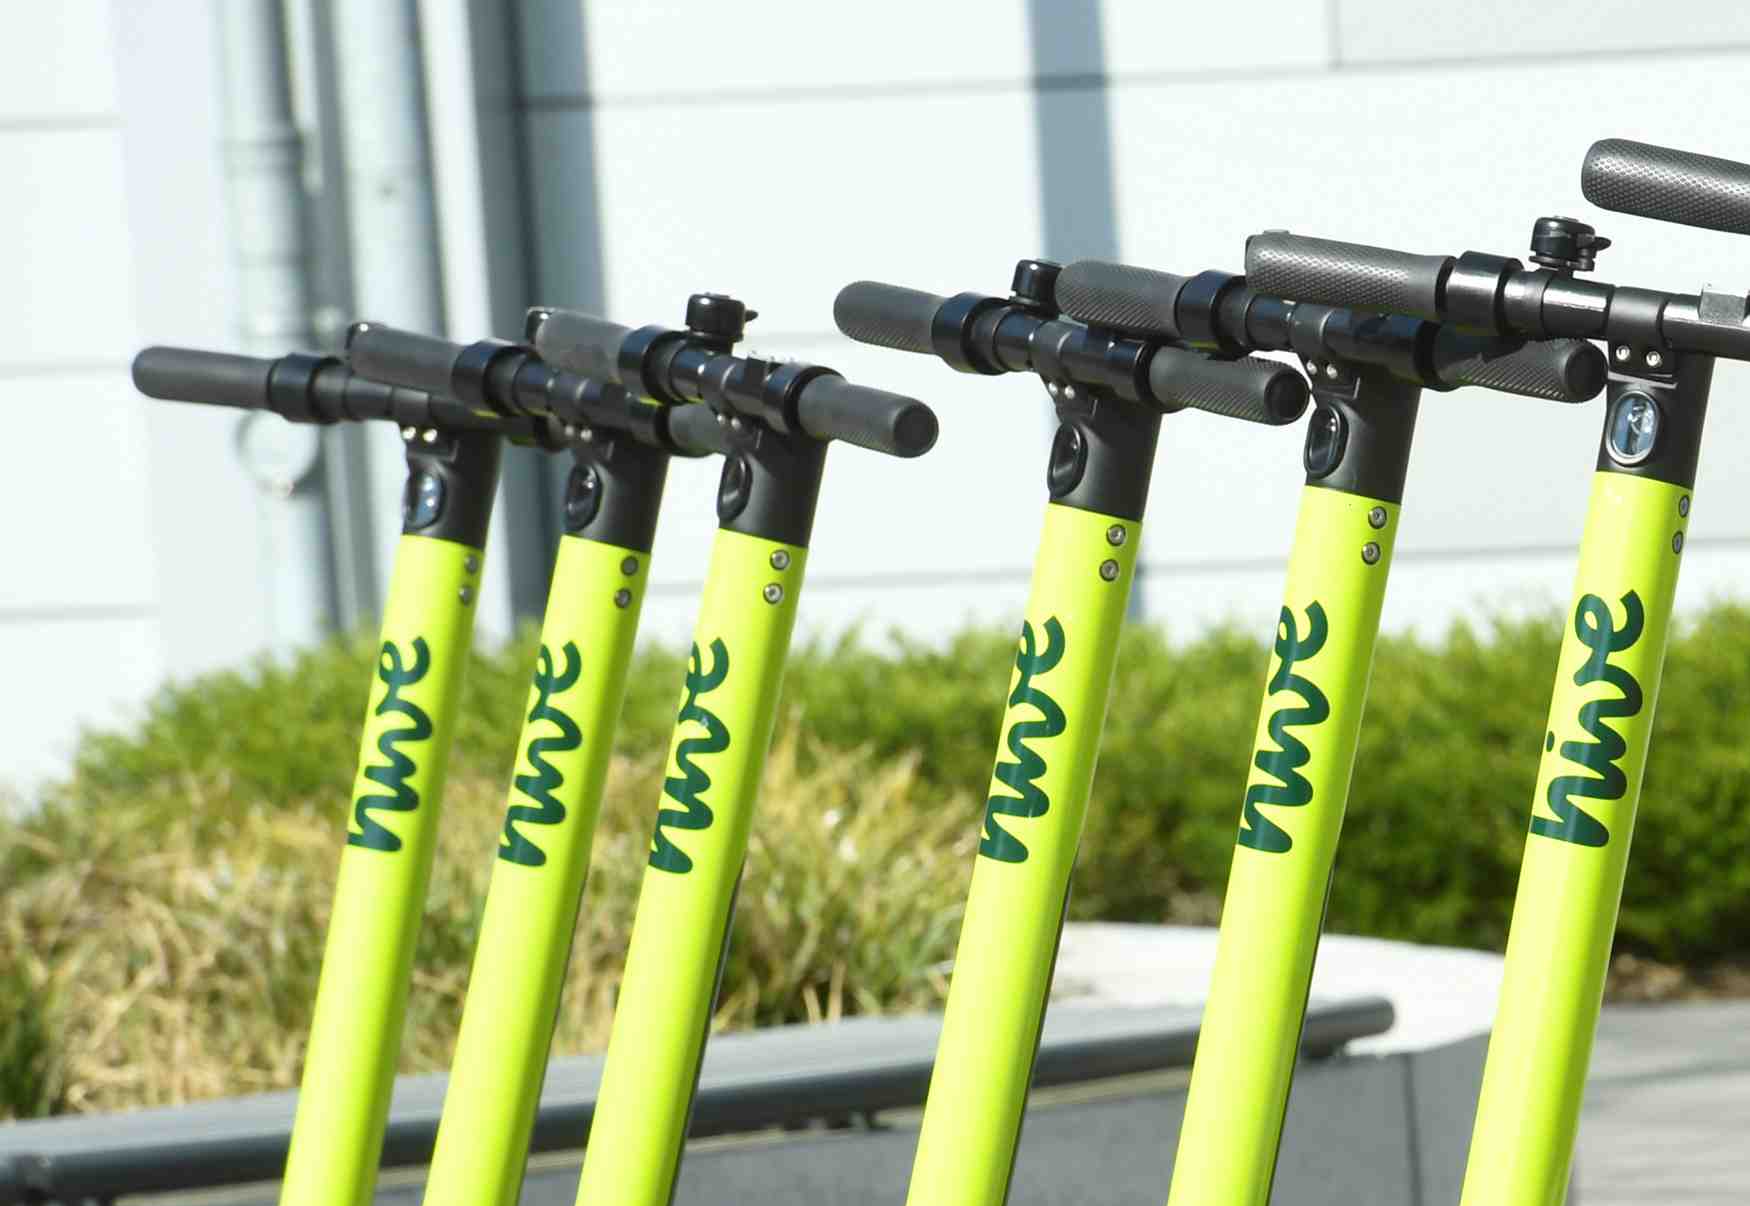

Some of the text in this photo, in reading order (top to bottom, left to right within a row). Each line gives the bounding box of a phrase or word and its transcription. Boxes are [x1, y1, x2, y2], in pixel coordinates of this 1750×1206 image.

[347, 636, 432, 852] hive
[498, 640, 582, 867] hive
[648, 637, 730, 874] hive
[978, 614, 1067, 863] hive
[1235, 599, 1330, 854] hive
[1529, 588, 1645, 848] hive
